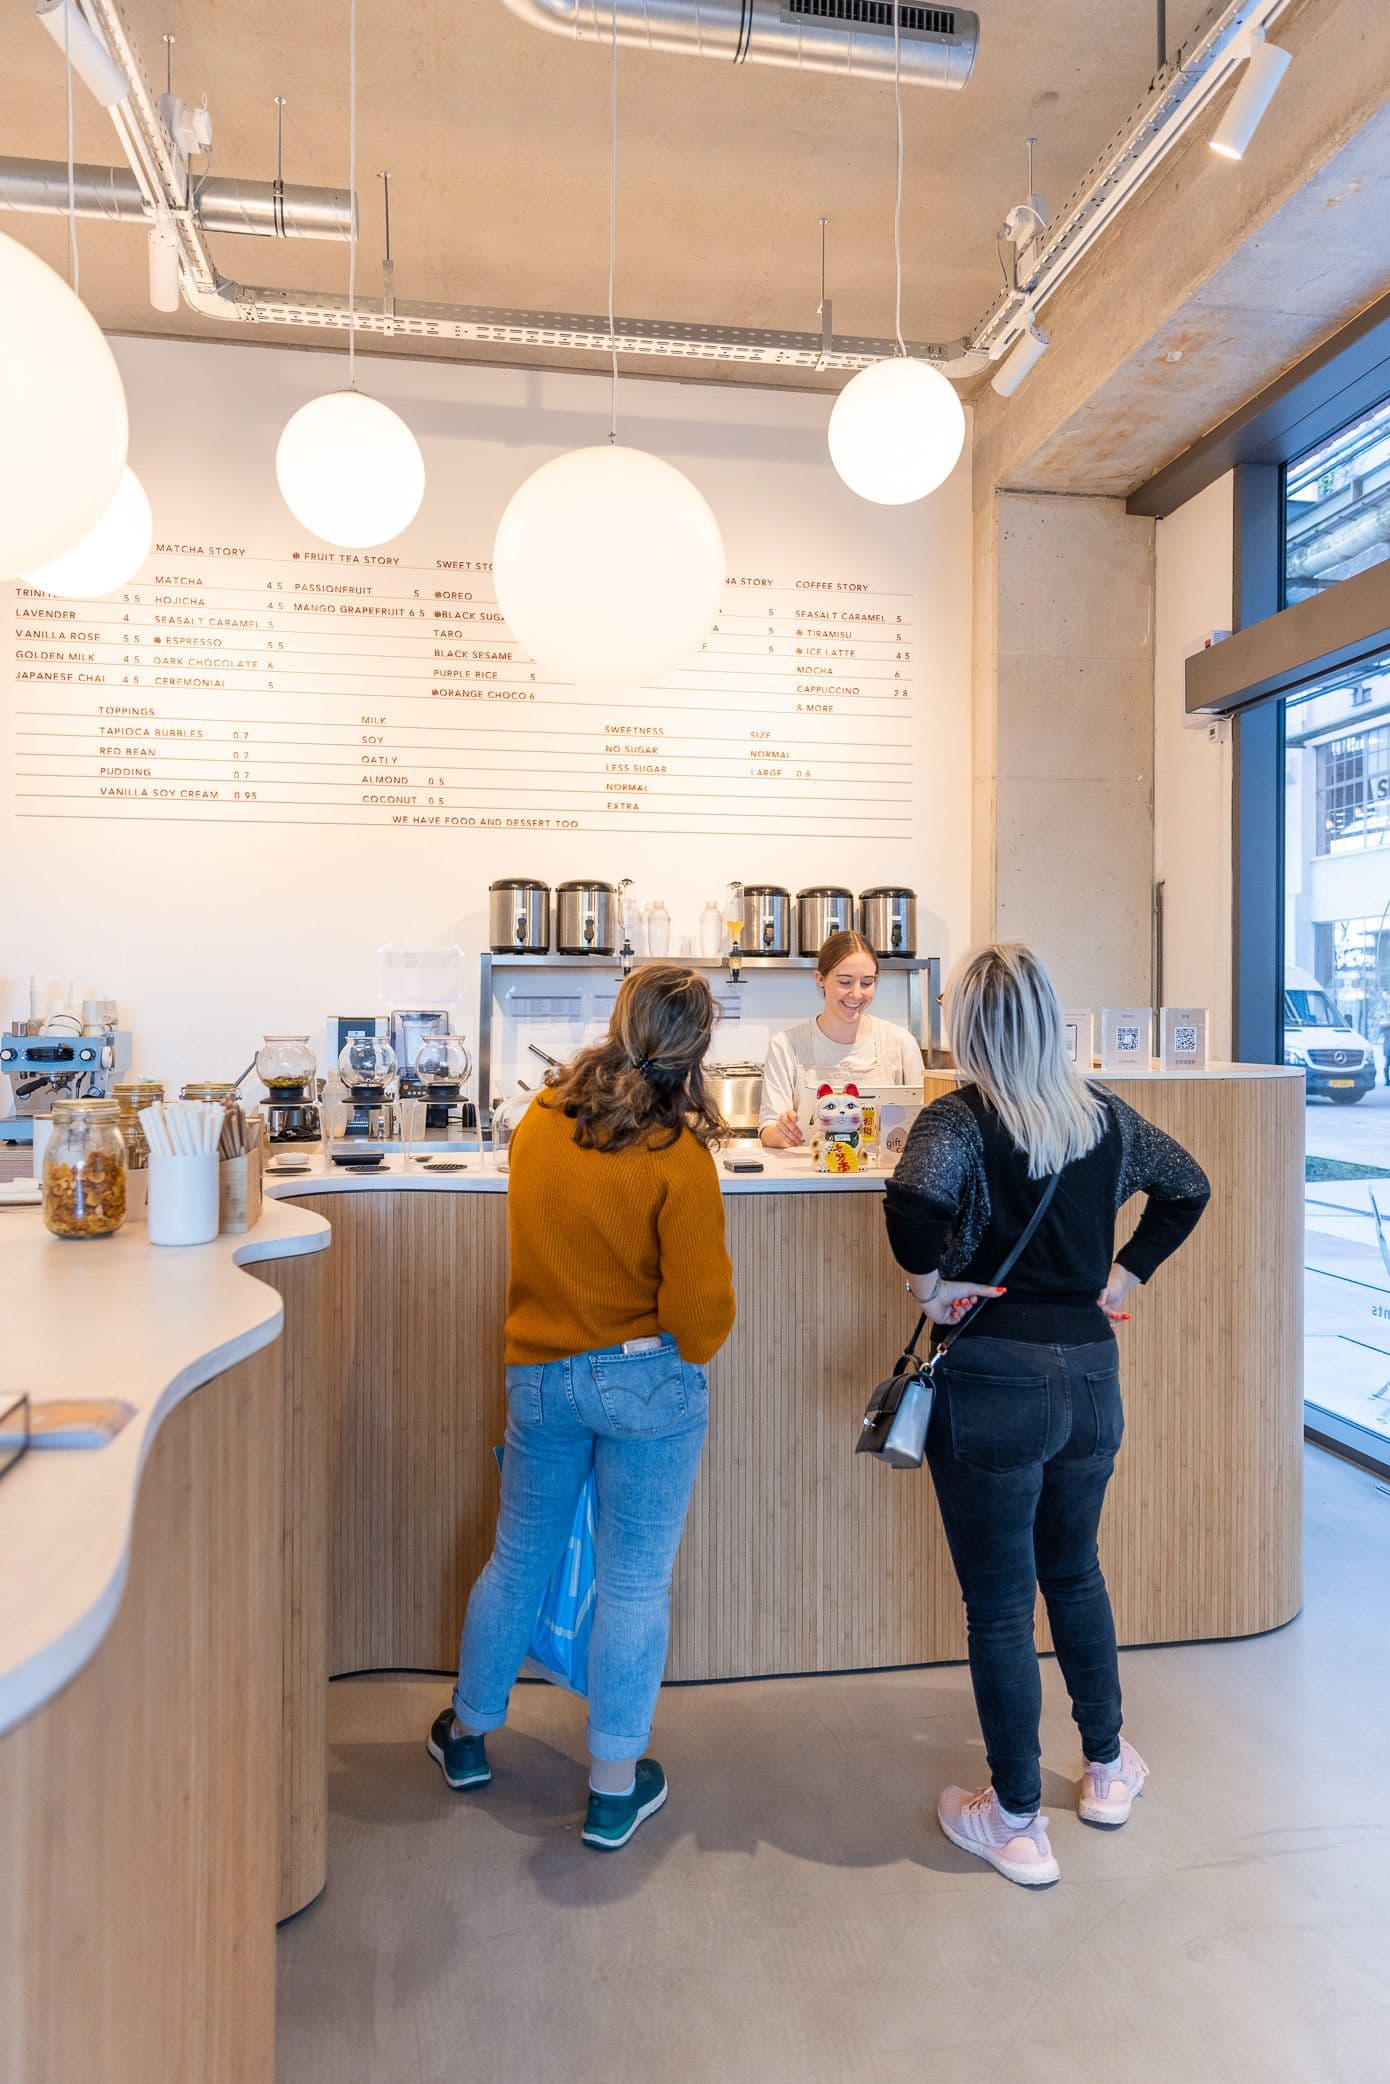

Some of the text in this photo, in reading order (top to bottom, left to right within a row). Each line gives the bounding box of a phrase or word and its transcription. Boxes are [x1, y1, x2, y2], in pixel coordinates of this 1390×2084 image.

[155, 544, 245, 557] MATCHA STORY
[304, 552, 400, 566] FRUIT TEA STORY
[436, 559, 472, 570] SWEET
[154, 576, 204, 586] MATCHA
[739, 577, 775, 588] STORY
[794, 580, 869, 592] COFFEE STORY
[295, 584, 374, 595] PASSIONFRUIT
[153, 595, 206, 606] HOJICHA
[441, 591, 472, 600] OREO
[16, 608, 76, 620] LAVENDER
[294, 602, 337, 614] MANGO
[338, 605, 405, 616] GRAPEFRUIT
[440, 610, 477, 620] BLACK
[795, 610, 838, 621] SEASALT
[841, 611, 886, 623] CARAMEL
[155, 616, 204, 625] SEASALT
[209, 617, 260, 630] CARAMEL
[16, 629, 66, 640] VANILLA
[70, 632, 101, 643] ROSE
[433, 628, 464, 638] TARO
[806, 629, 852, 639] TIRAMISU
[166, 636, 223, 647] ESPRESSO
[16, 650, 64, 660] GOLDEN
[69, 652, 95, 662] MILK
[434, 648, 513, 661] BLACK SESAME
[806, 647, 822, 656] ICE
[825, 648, 857, 658] LATTE
[154, 656, 186, 665] DARK
[187, 657, 258, 668] CHOCOLATE
[433, 668, 471, 679] PURPLE
[475, 671, 499, 680] RICE
[796, 665, 833, 675] MOCHA
[16, 672, 73, 681] JAPANESE
[78, 673, 105, 682] CHAI
[153, 677, 224, 687] CEREMONIAL
[438, 688, 483, 698] ORANGE
[487, 690, 527, 700] CHOCO
[796, 684, 862, 695] CAPPUCCINO
[98, 705, 156, 716] TOPPINGS
[807, 704, 834, 712] MORE
[361, 715, 387, 724] MILK
[99, 727, 153, 736] TAPIOCA
[153, 728, 205, 738] BUBBLES
[603, 725, 664, 735] SWEETNESS
[750, 730, 771, 739] SIZE
[360, 736, 384, 744] SOY
[100, 747, 122, 755] RED
[126, 747, 156, 756] BEAN
[622, 745, 658, 754] SUGAR
[750, 750, 791, 759] NORMAL
[361, 755, 397, 764] OATLY
[100, 768, 151, 776] PUDDING
[606, 764, 668, 773] LESS SUGAR
[360, 776, 408, 784] ALMOND
[98, 787, 150, 797] VANILLA
[153, 789, 178, 798] SOY
[179, 789, 218, 799] CREAM
[360, 794, 417, 804] COCONUT
[607, 802, 639, 810] EXTRA
[413, 816, 441, 824] HAVE
[444, 817, 478, 825] FOOD
[479, 817, 503, 826] AND
[505, 818, 551, 827] DESSERT
[555, 820, 578, 828] TOO
[886, 1138, 902, 1149] gift
